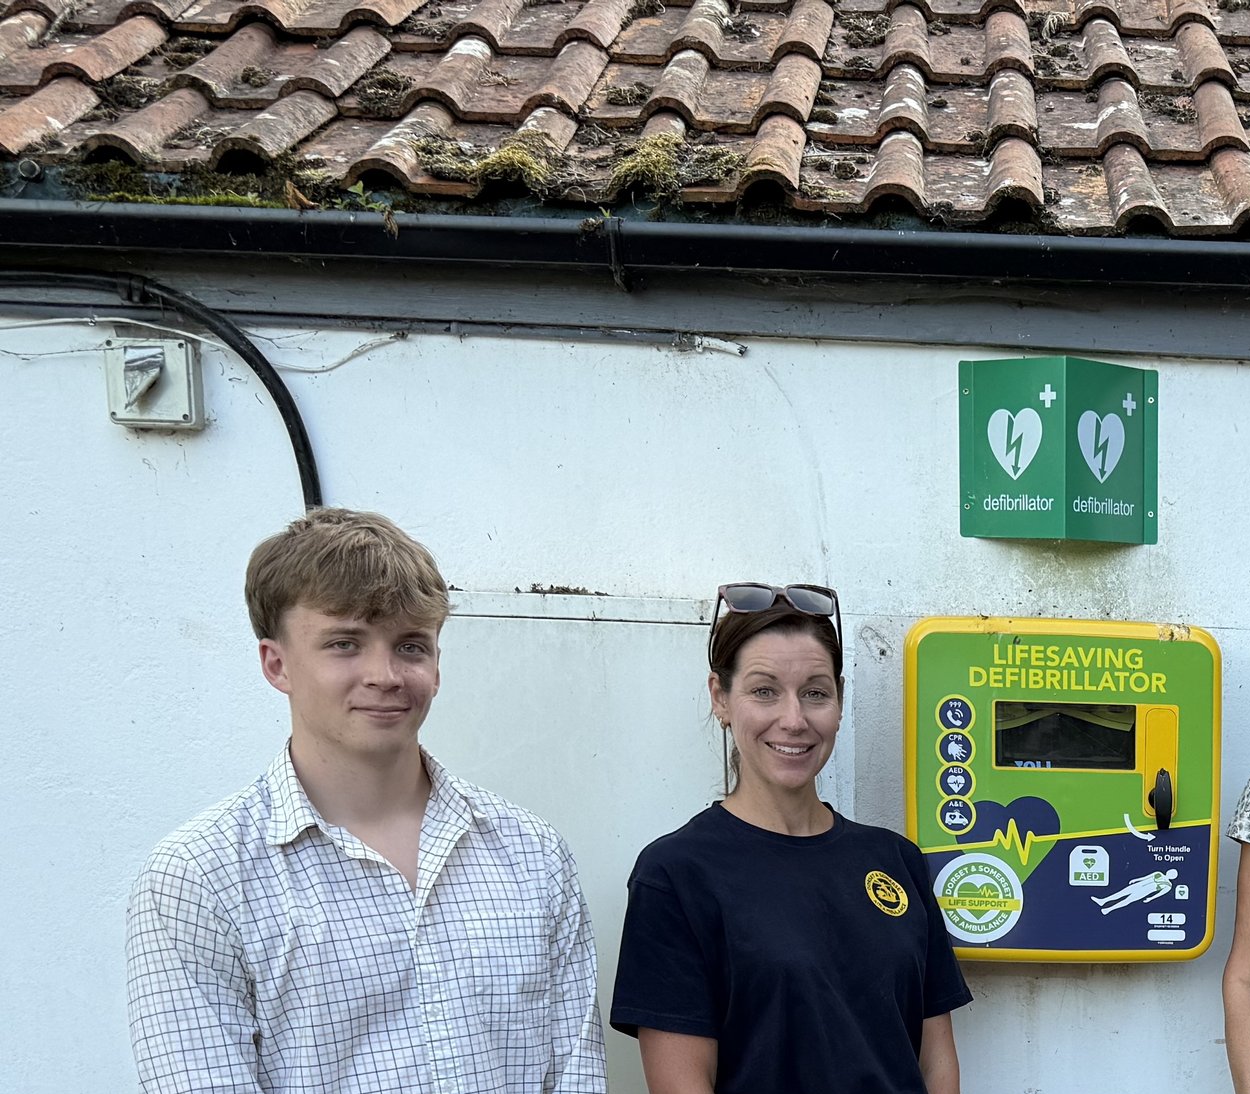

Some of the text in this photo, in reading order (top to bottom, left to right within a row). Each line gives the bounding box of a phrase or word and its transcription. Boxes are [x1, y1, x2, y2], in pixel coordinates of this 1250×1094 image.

[983, 494, 1054, 511] defibrillator
[1073, 496, 1135, 516] defibrillator
[993, 644, 1143, 670] LIFESAVING
[969, 666, 1167, 693] DEFIBRILLATOR
[1147, 844, 1164, 852] Turn
[1153, 853, 1184, 862] To Open
[945, 867, 969, 895] DORSET
[978, 865, 1012, 898] SOMERSET
[968, 899, 1008, 908] SUPPORT
[947, 910, 1008, 932] AIR AMBULANCE
[1160, 914, 1173, 923] 14
